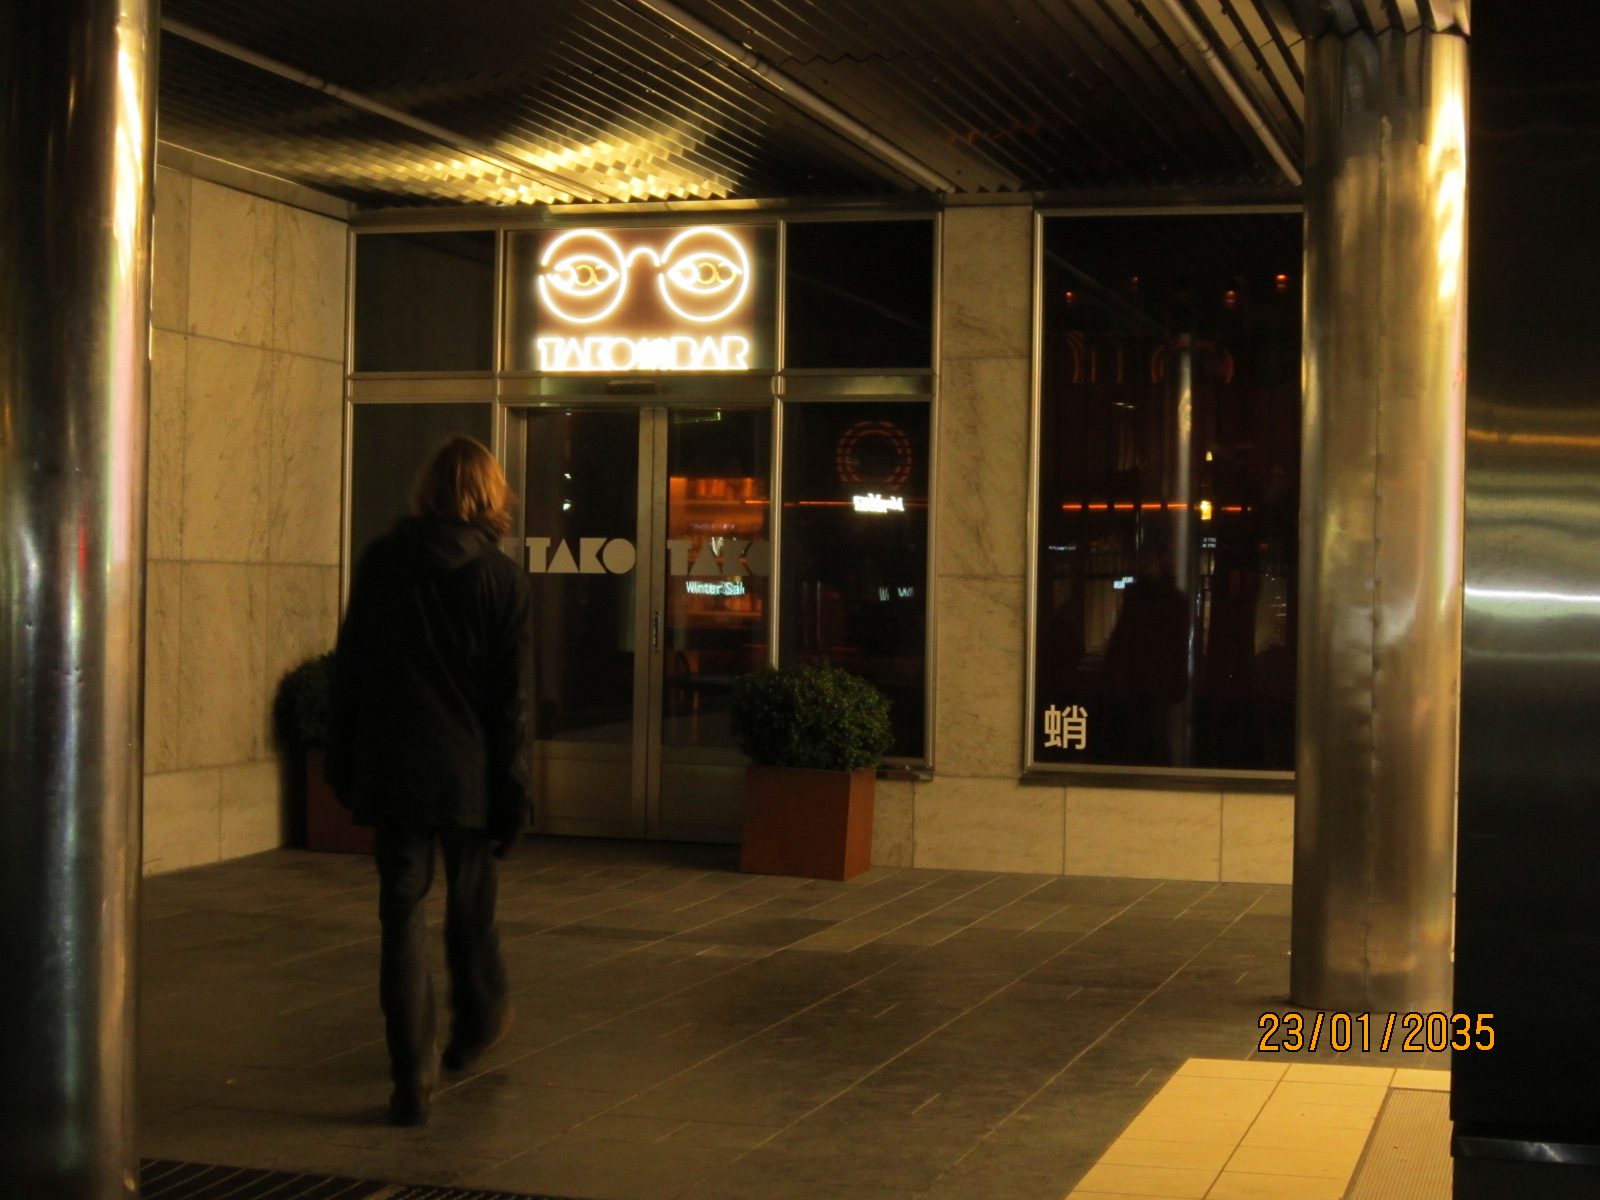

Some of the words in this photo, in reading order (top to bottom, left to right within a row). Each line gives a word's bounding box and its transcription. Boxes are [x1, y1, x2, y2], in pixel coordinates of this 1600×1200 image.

[537, 336, 635, 370] TAKO
[670, 336, 749, 370] BAR
[526, 537, 636, 574] TAKO
[667, 539, 769, 576] TAKO
[686, 580, 721, 595] Winter
[1044, 704, 1088, 750] 蛸
